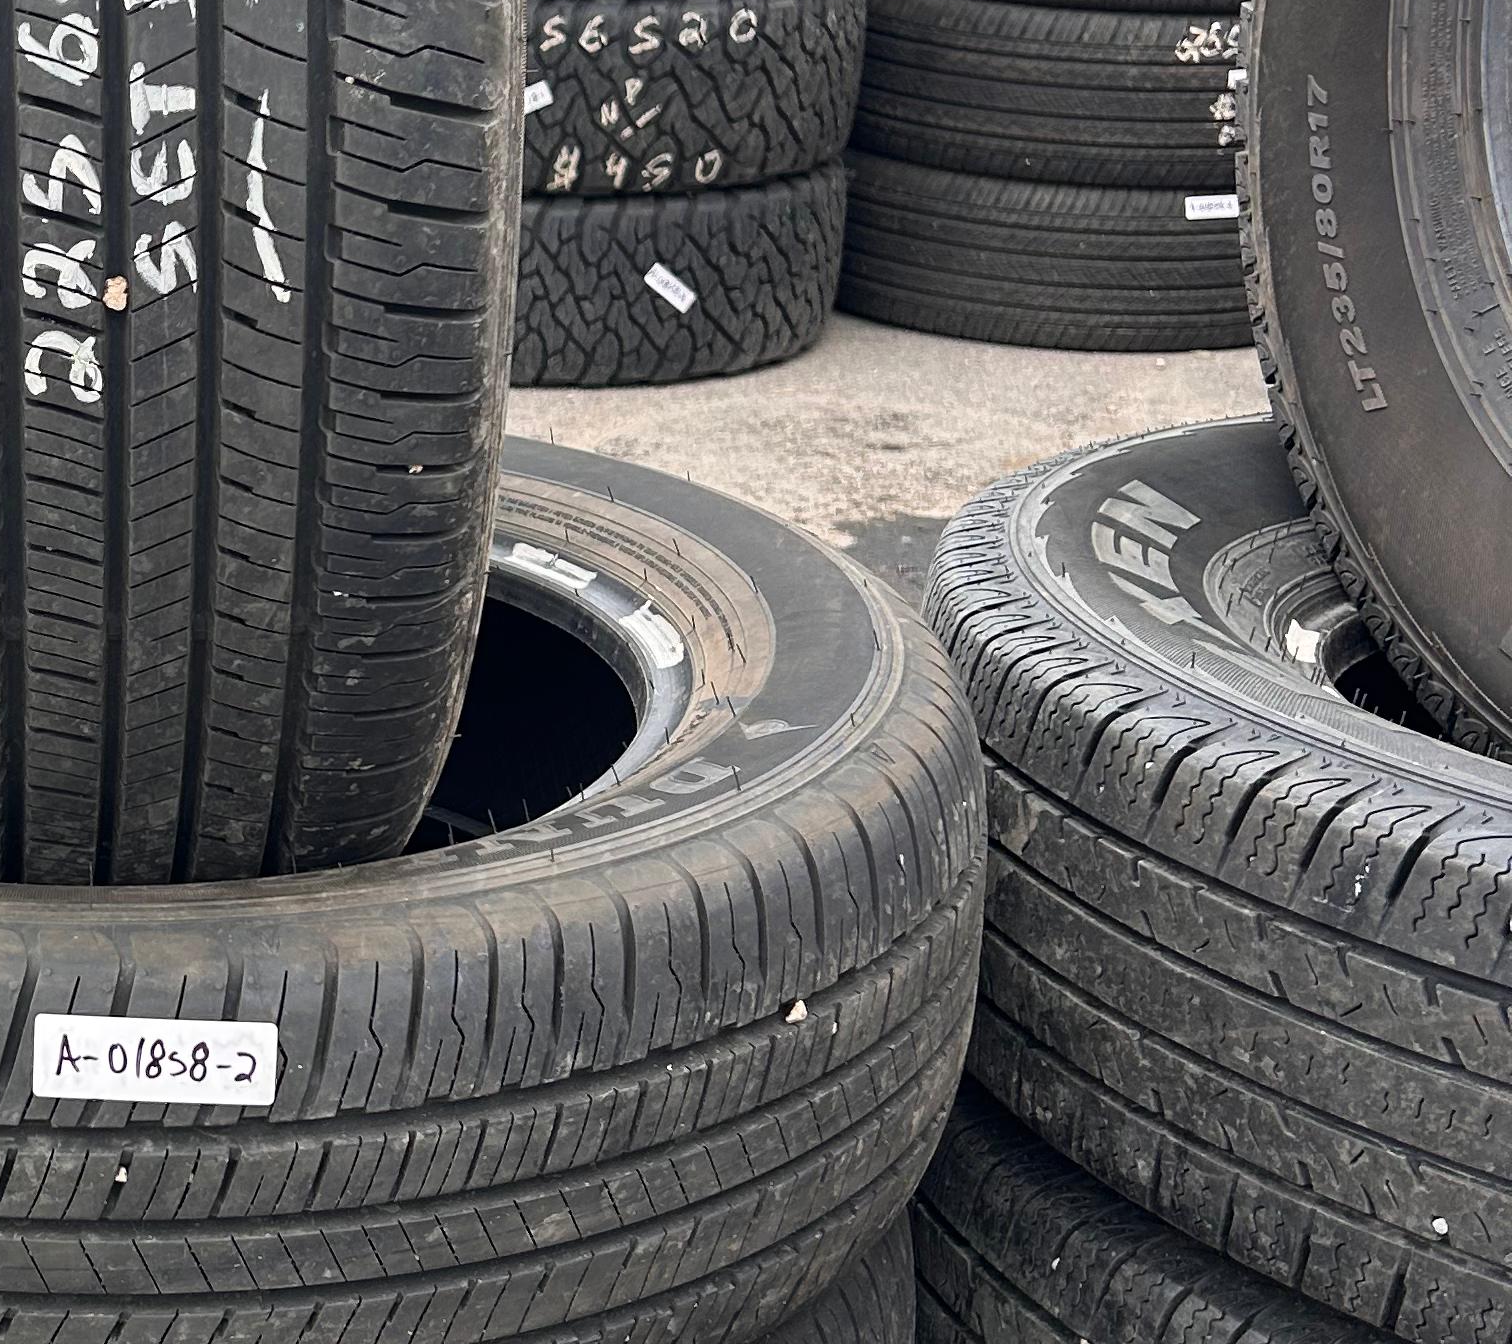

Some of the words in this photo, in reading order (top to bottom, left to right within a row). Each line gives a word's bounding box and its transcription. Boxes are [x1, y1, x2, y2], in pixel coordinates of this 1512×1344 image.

[21, 134, 104, 403] 225
[128, 62, 198, 296] SET
[1307, 74, 1388, 412] LT235/80R17
[56, 1034, 258, 1082] A-01858-2
